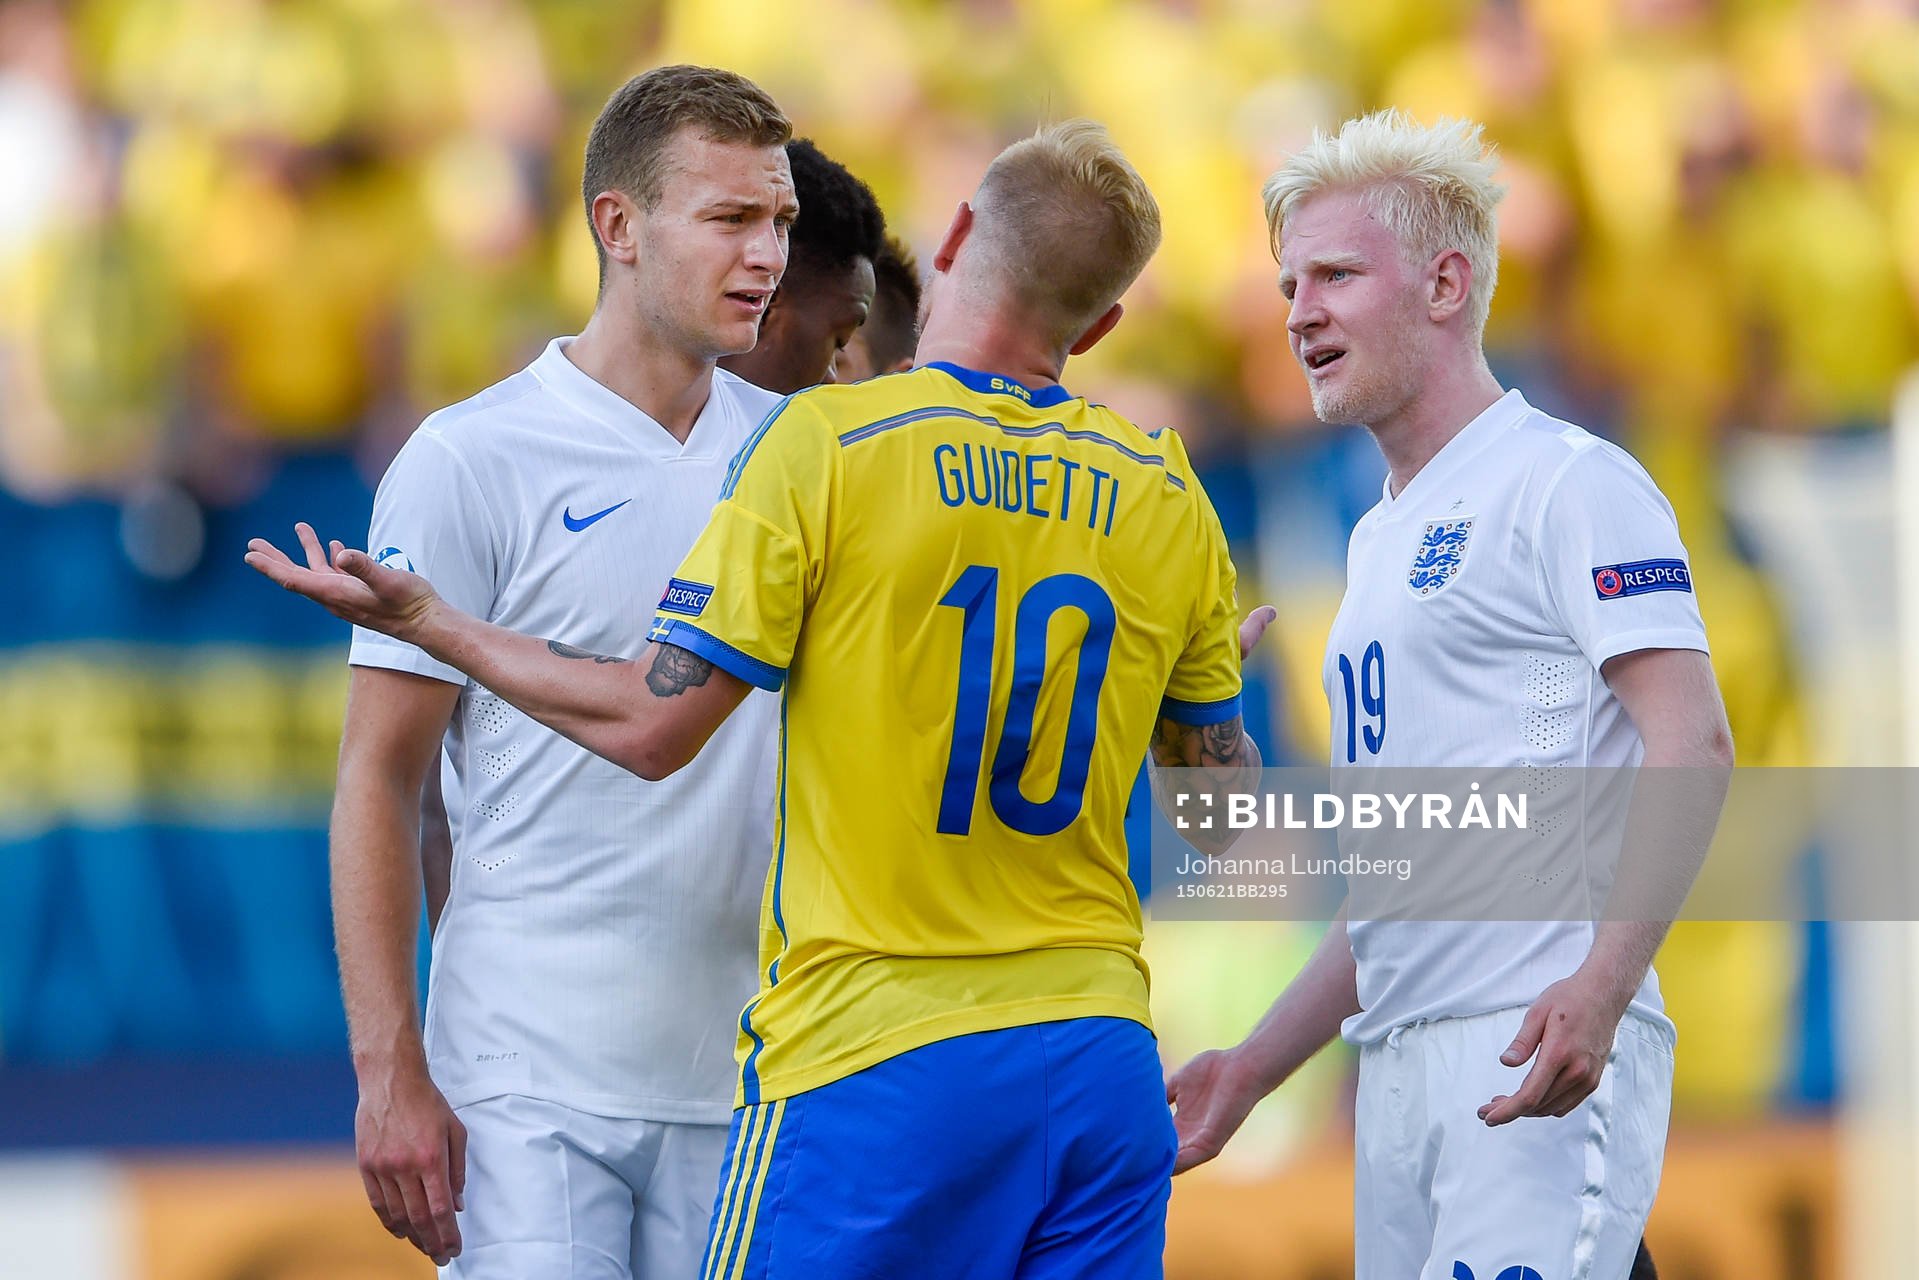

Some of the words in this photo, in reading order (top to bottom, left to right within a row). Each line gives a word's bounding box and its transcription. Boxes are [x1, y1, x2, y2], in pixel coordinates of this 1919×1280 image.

[990, 377, 1032, 401] SvFF
[933, 442, 1119, 537] GUIDETTI
[666, 587, 710, 608] RESPECT
[1623, 567, 1689, 587] RESPECT
[936, 564, 1117, 836] 10
[1338, 639, 1387, 764] 19
